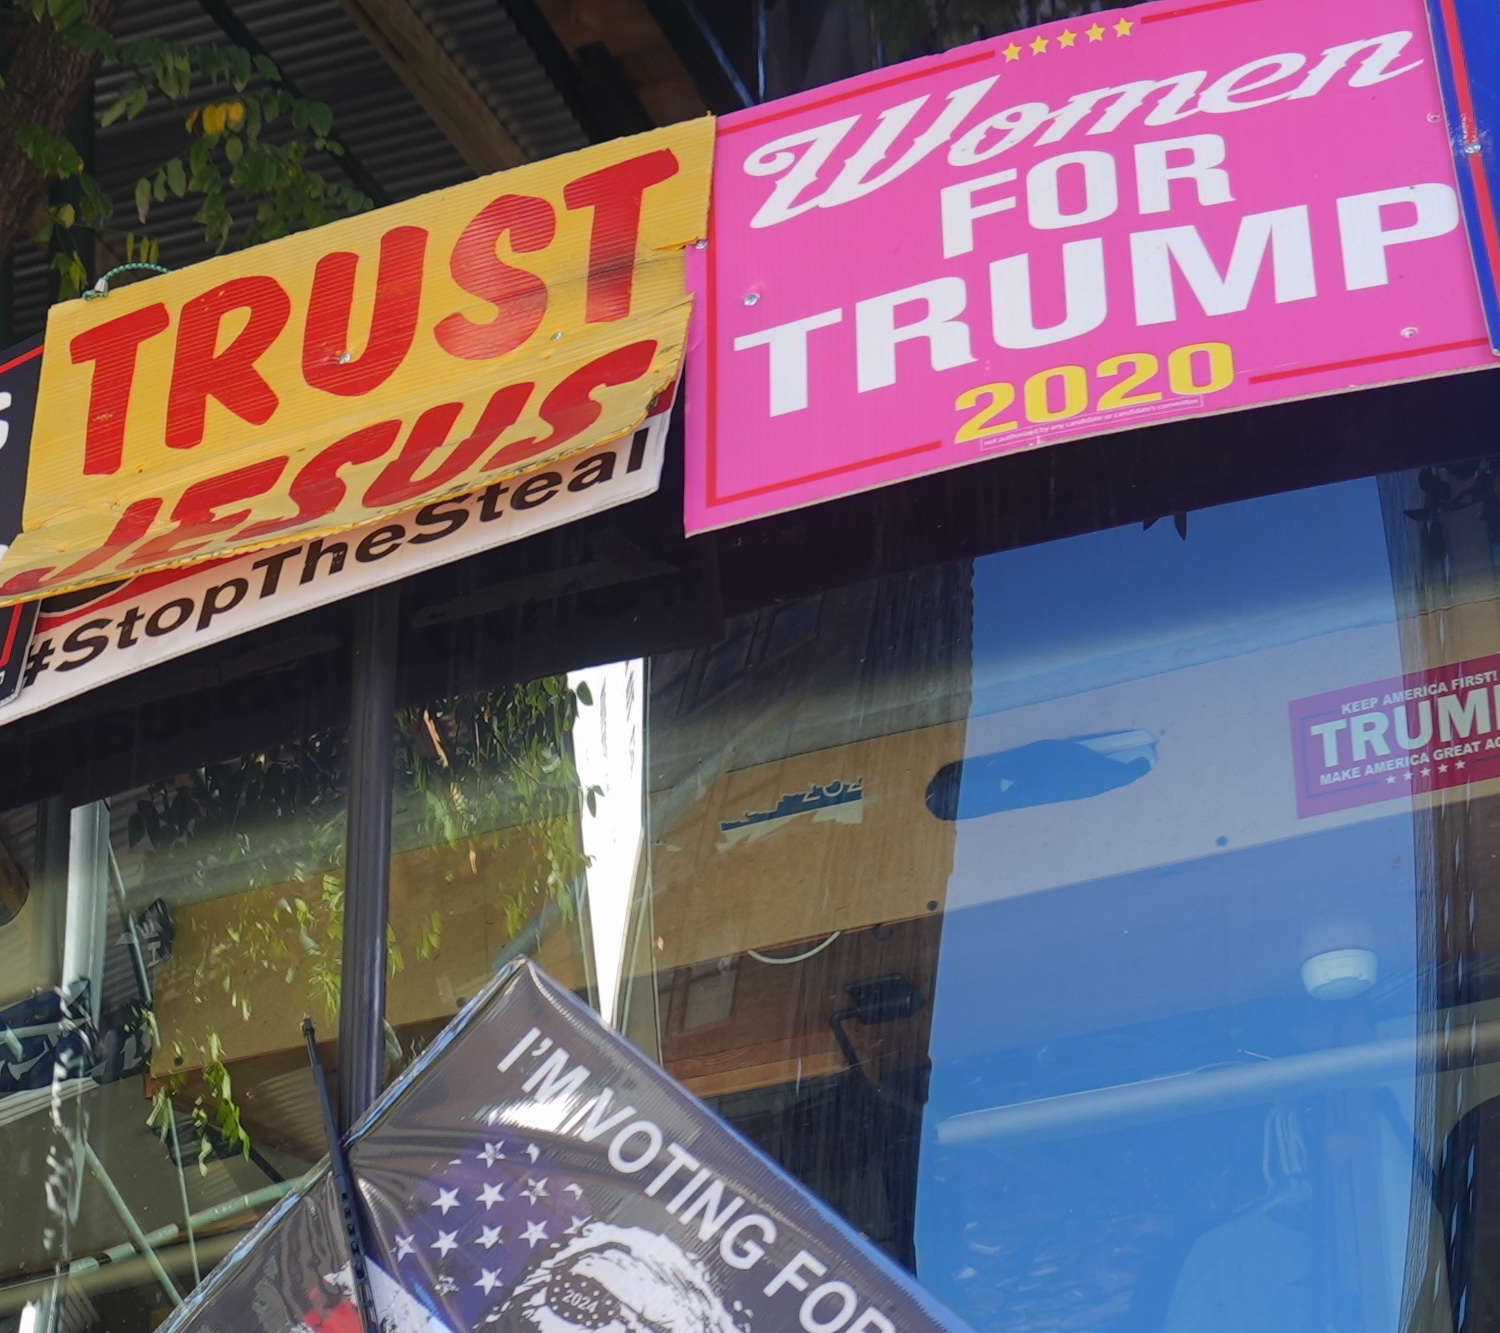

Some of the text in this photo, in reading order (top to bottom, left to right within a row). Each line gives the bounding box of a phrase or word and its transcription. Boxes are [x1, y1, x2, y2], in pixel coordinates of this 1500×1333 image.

[743, 30, 1424, 229] Women
[940, 133, 1236, 259] FOR
[70, 147, 680, 475] TRUST
[734, 183, 1460, 417] TRUMP
[954, 342, 1234, 443] 2020
[24, 430, 645, 686] #StopTheSteal
[1320, 767, 1361, 786] MAKE
[1363, 753, 1430, 777] AMERICA
[1432, 740, 1481, 765] GREAT
[1341, 671, 1498, 714] KEEP AMERICA FIRST!
[579, 1086, 776, 1270] VOTING
[561, 1285, 598, 1315] 2024
